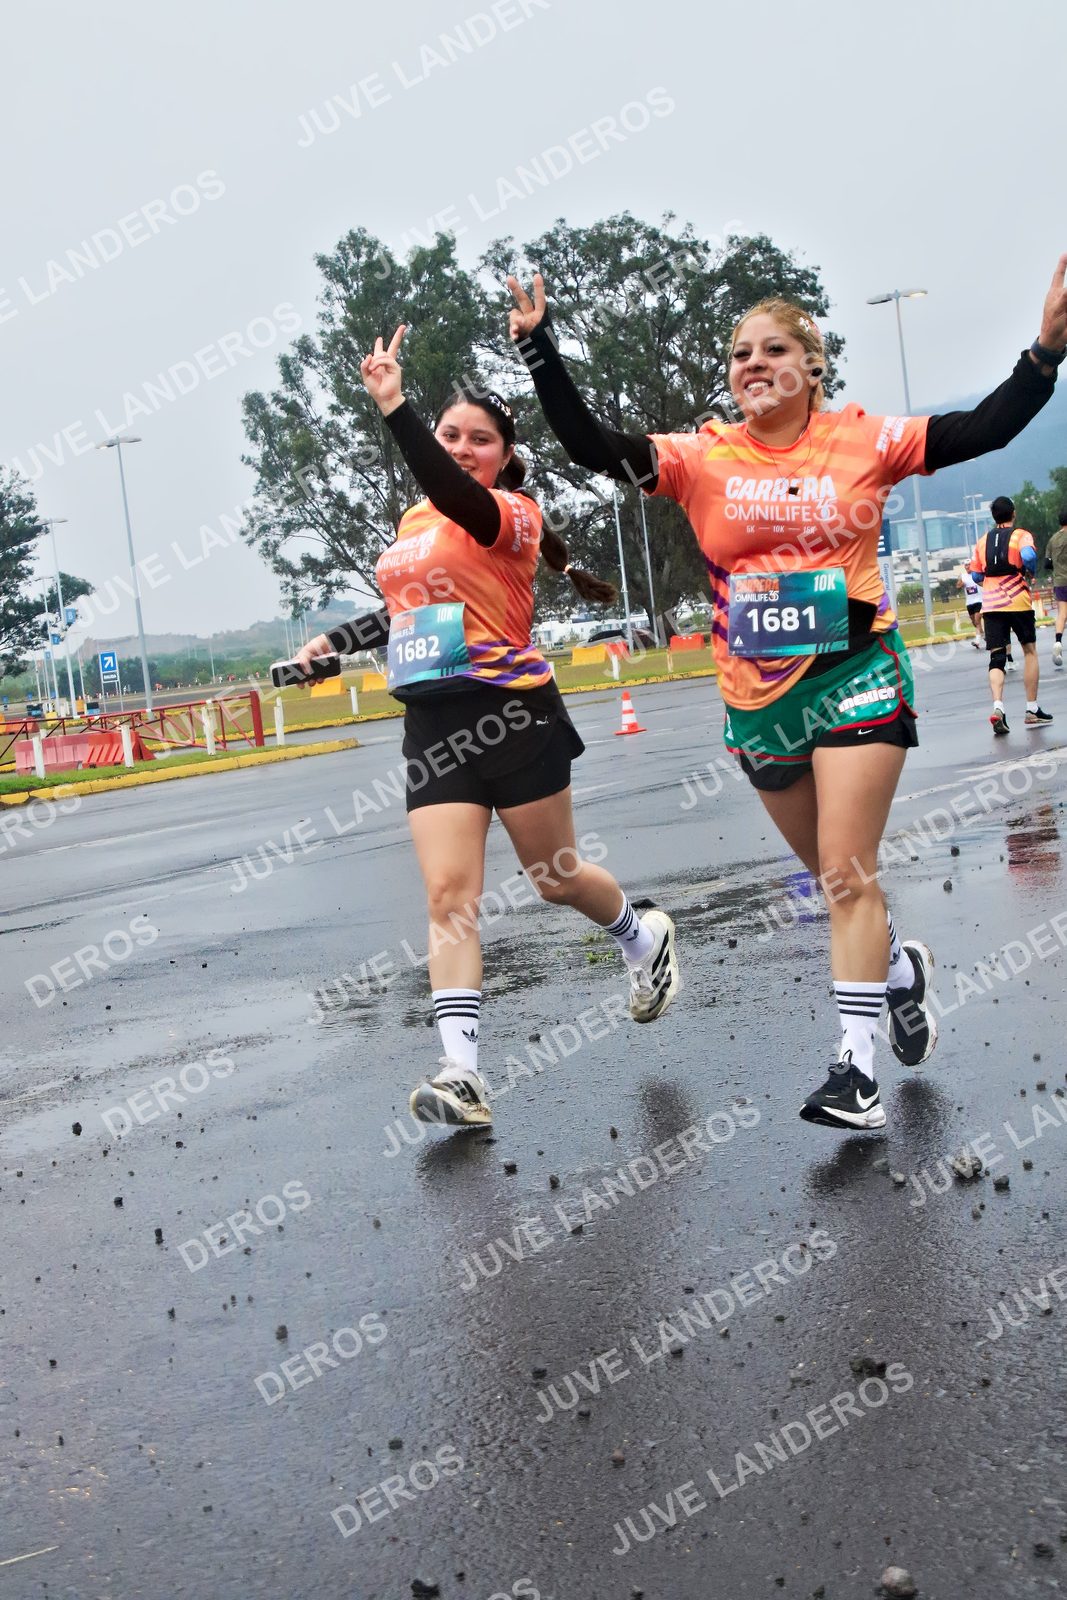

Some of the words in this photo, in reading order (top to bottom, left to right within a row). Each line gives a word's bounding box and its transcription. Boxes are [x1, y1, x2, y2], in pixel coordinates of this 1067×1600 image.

[725, 475, 837, 502] CARRERA
[724, 503, 812, 522] OMNILIFE
[814, 573, 836, 592] 10K
[735, 593, 768, 602] OMNILIFE
[437, 606, 454, 623] 10K
[746, 605, 816, 633] 1681
[396, 635, 440, 665] 1682
